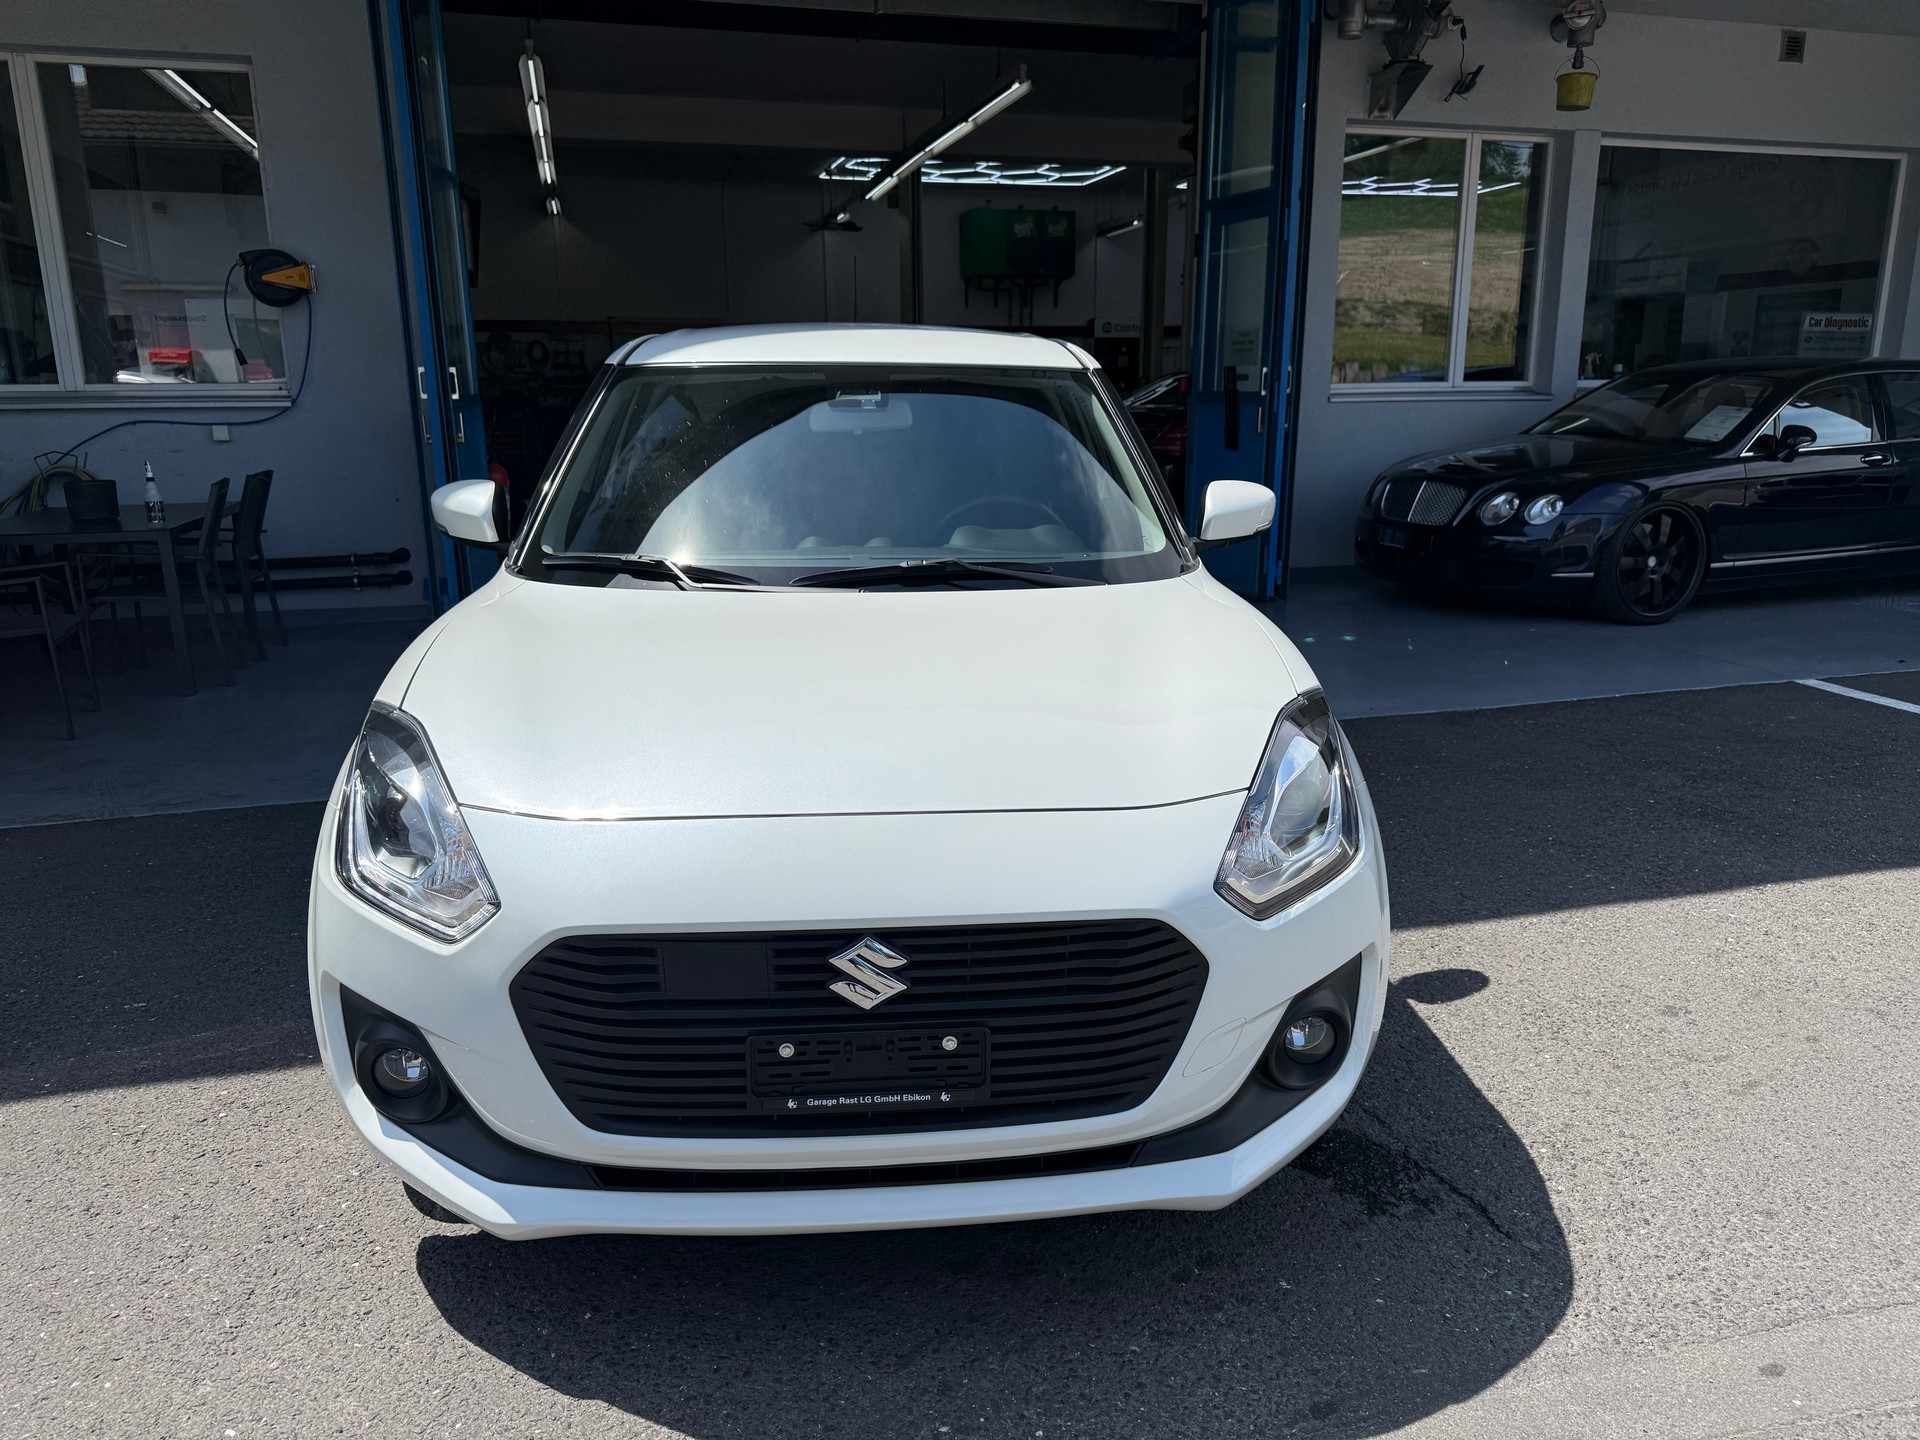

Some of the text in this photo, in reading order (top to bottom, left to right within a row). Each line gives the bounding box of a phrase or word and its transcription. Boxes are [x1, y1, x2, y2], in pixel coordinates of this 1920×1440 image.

[1808, 316, 1869, 330] Car Diagnostic
[807, 1098, 837, 1107] Garage
[839, 1097, 858, 1105] Rast
[860, 1096, 872, 1104] LG
[874, 1094, 901, 1103] GmbH
[903, 1093, 931, 1102] Ebikon
